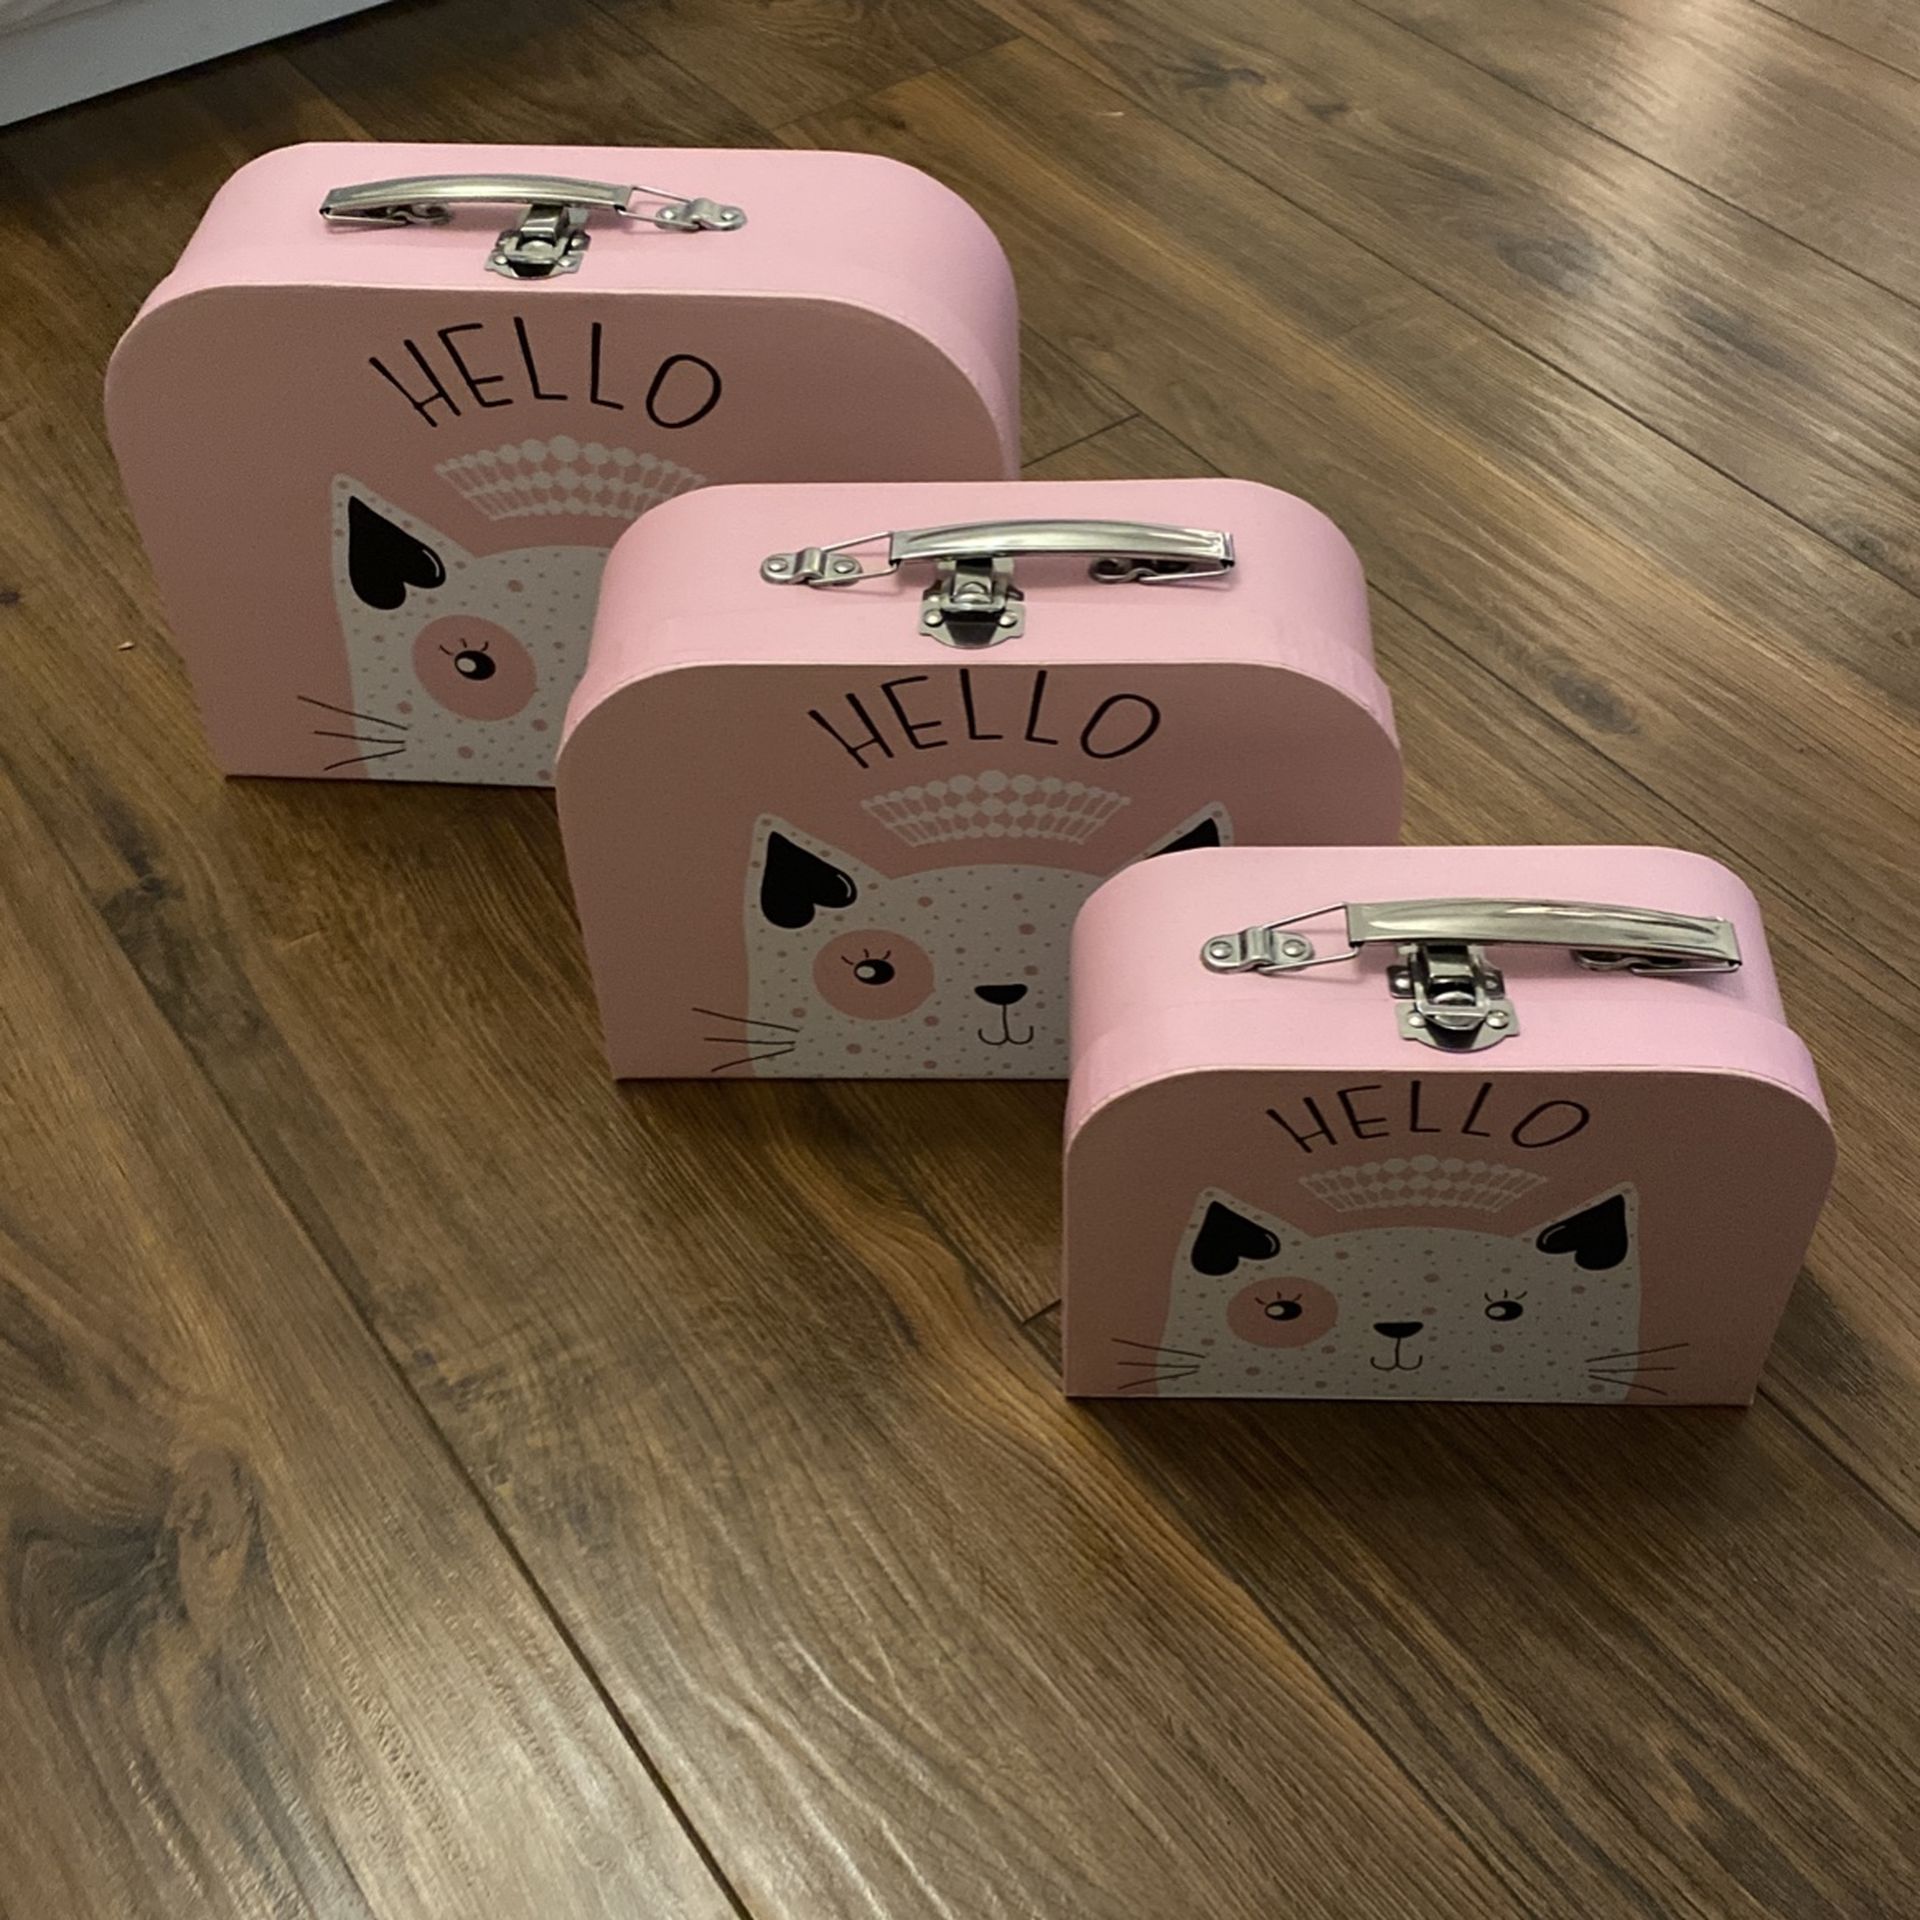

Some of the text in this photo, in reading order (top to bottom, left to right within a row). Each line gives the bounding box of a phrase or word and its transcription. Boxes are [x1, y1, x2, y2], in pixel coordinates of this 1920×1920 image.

[368, 316, 723, 430] HELLO
[807, 667, 1162, 770] HELLO
[1266, 1079, 1591, 1154] HELLO
